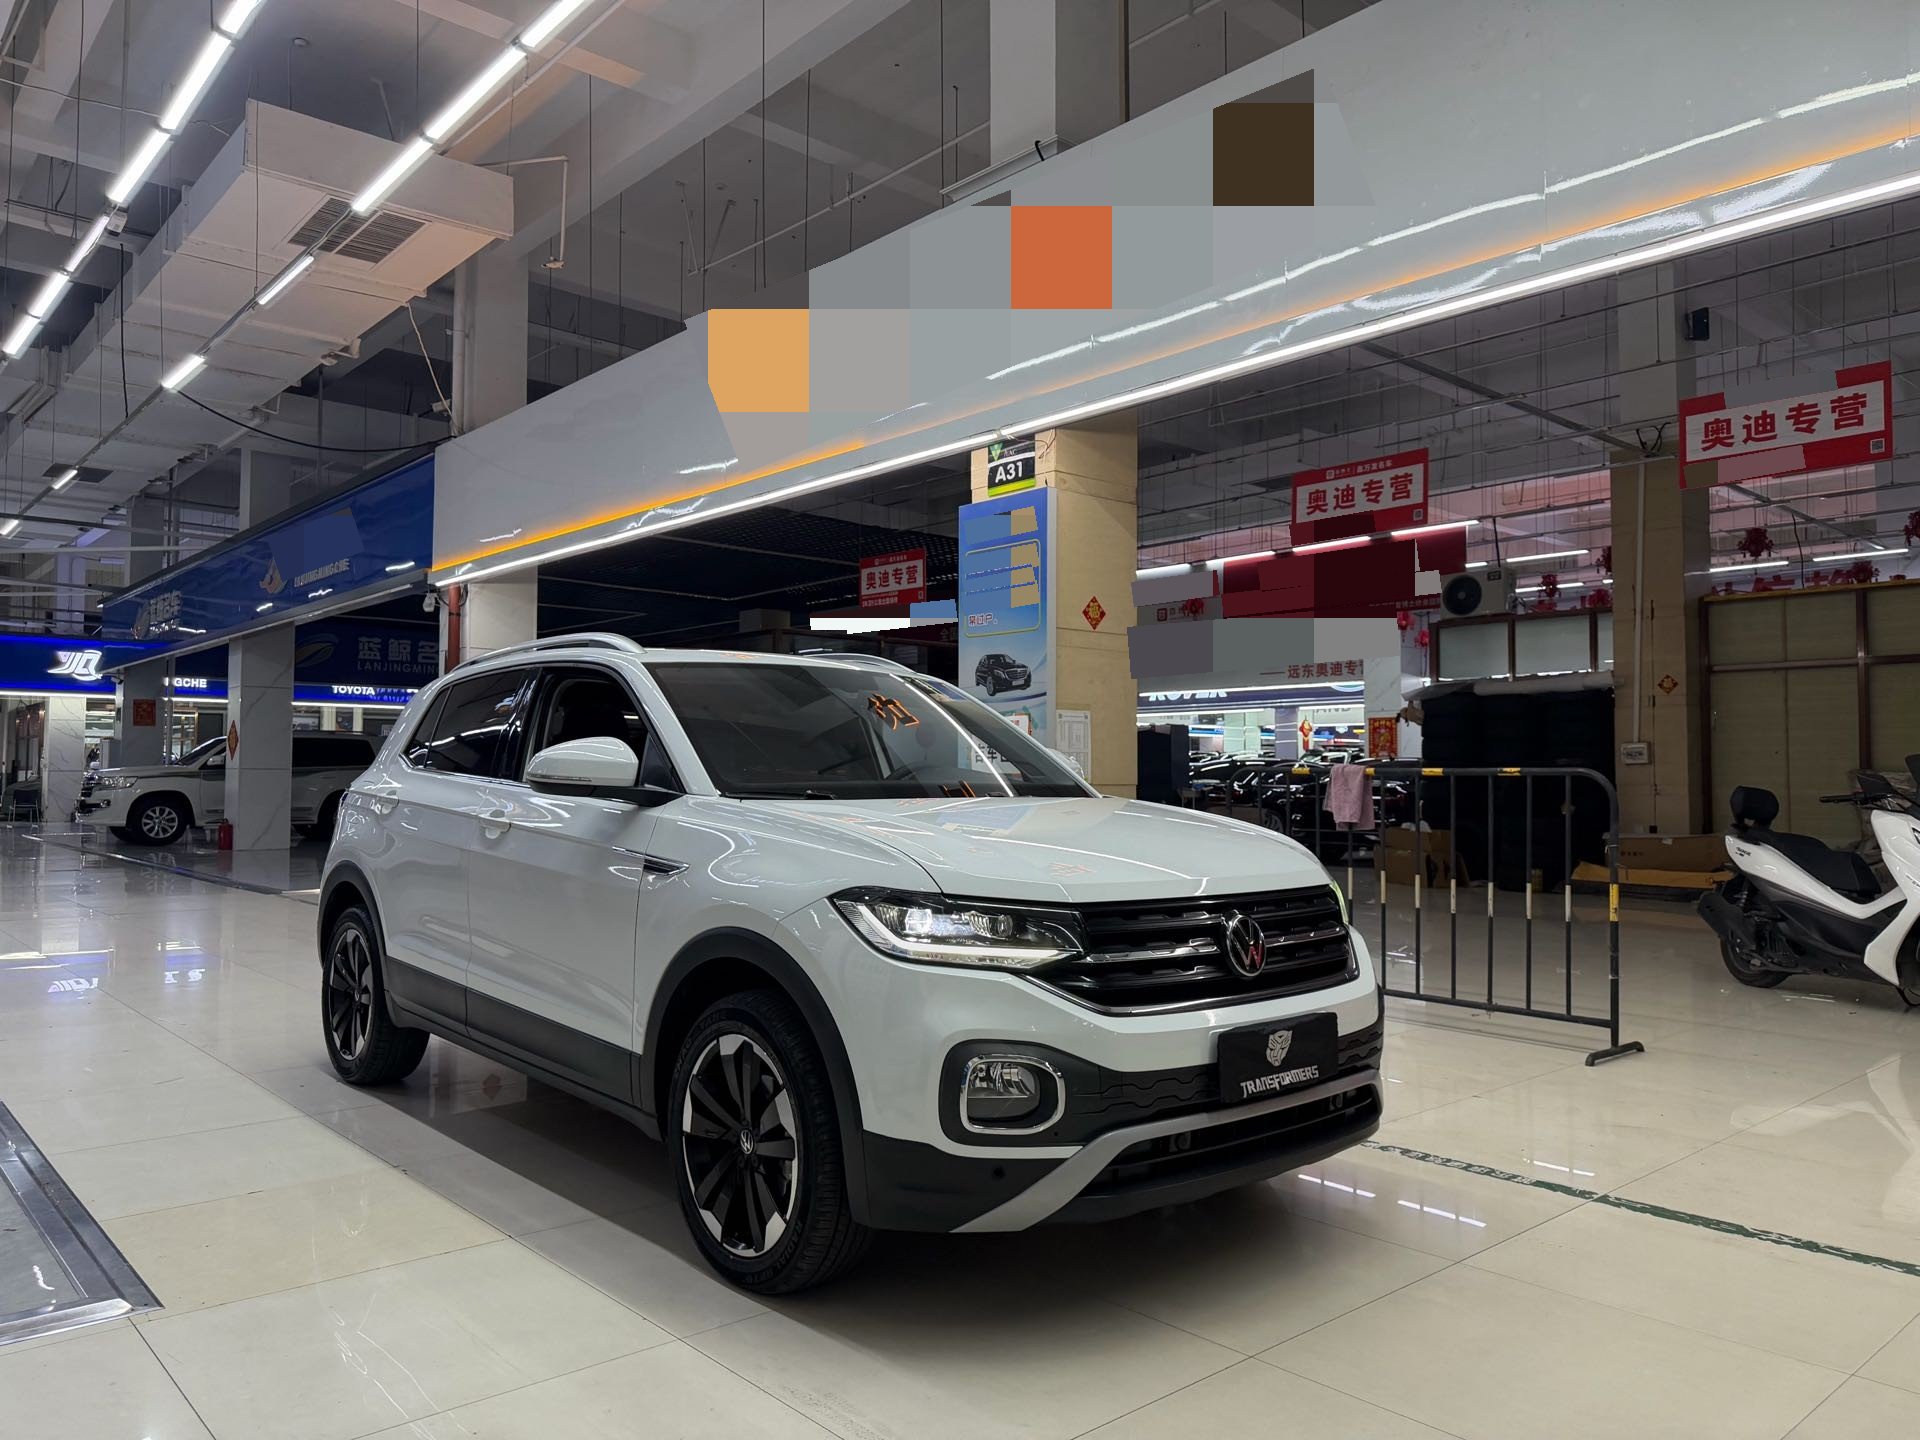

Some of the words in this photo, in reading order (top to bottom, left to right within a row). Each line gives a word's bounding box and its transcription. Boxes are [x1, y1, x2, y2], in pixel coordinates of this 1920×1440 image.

[1701, 392, 1868, 452] 奥迪专营
[995, 461, 1023, 483] A31
[1306, 472, 1413, 515] 奥迪专营
[866, 565, 918, 591] 奥迪专营
[357, 660, 439, 675] LANJINGMIN
[1288, 659, 1364, 679] 远东奥迪专
[331, 685, 376, 696] TOYOTA
[1240, 1065, 1320, 1098] TRANSFORMERS
